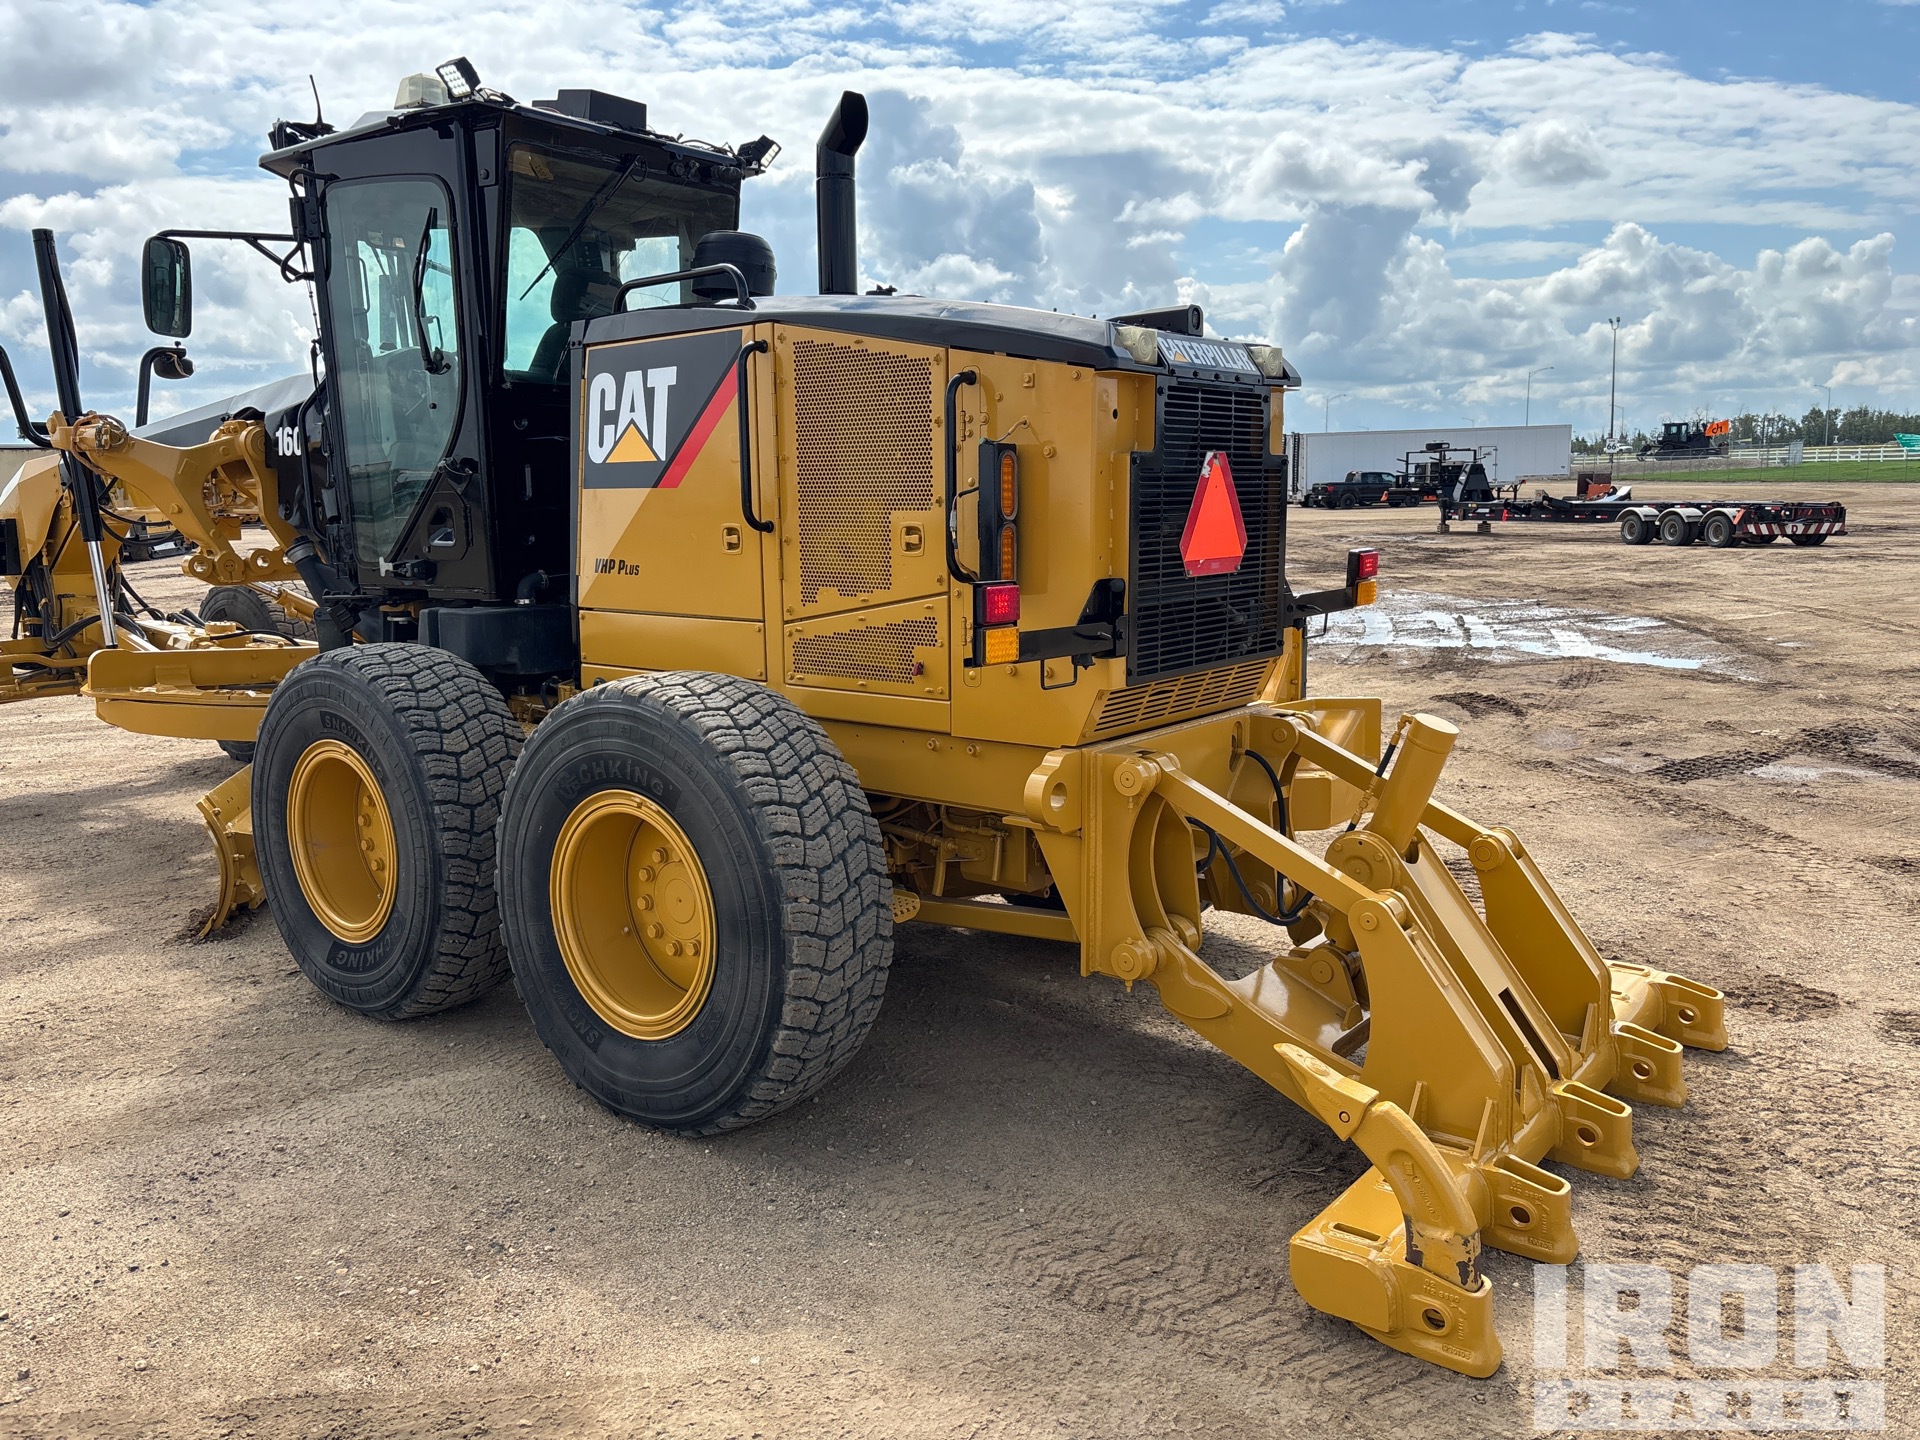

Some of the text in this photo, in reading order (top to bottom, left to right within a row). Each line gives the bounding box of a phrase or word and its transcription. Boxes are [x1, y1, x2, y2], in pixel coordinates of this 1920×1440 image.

[1158, 337, 1256, 371] CATERPILLAR
[588, 366, 677, 464] CAT
[1606, 442, 1617, 450] 66
[594, 558, 616, 575] VHP
